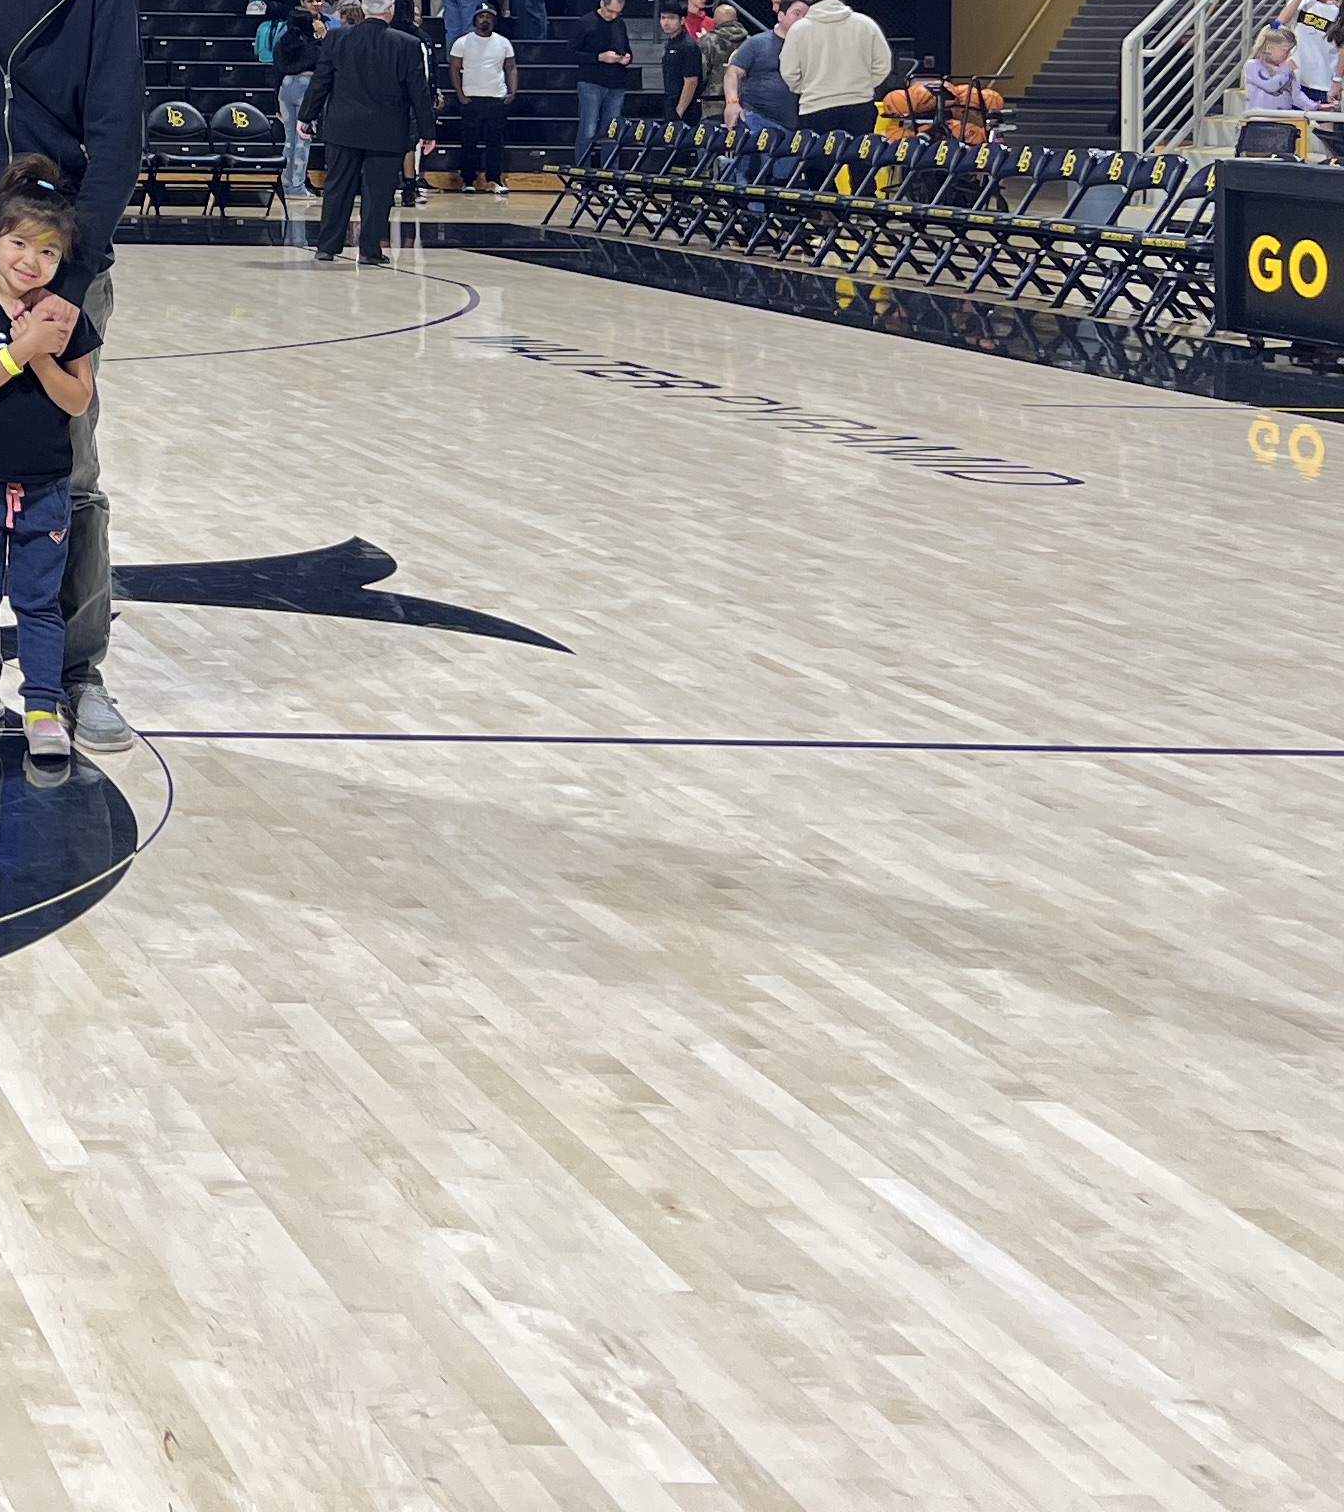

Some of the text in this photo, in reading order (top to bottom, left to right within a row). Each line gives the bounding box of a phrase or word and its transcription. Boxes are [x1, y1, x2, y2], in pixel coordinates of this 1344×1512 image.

[1248, 234, 1329, 299] GO
[455, 335, 1086, 486] WALTER PYRAMID
